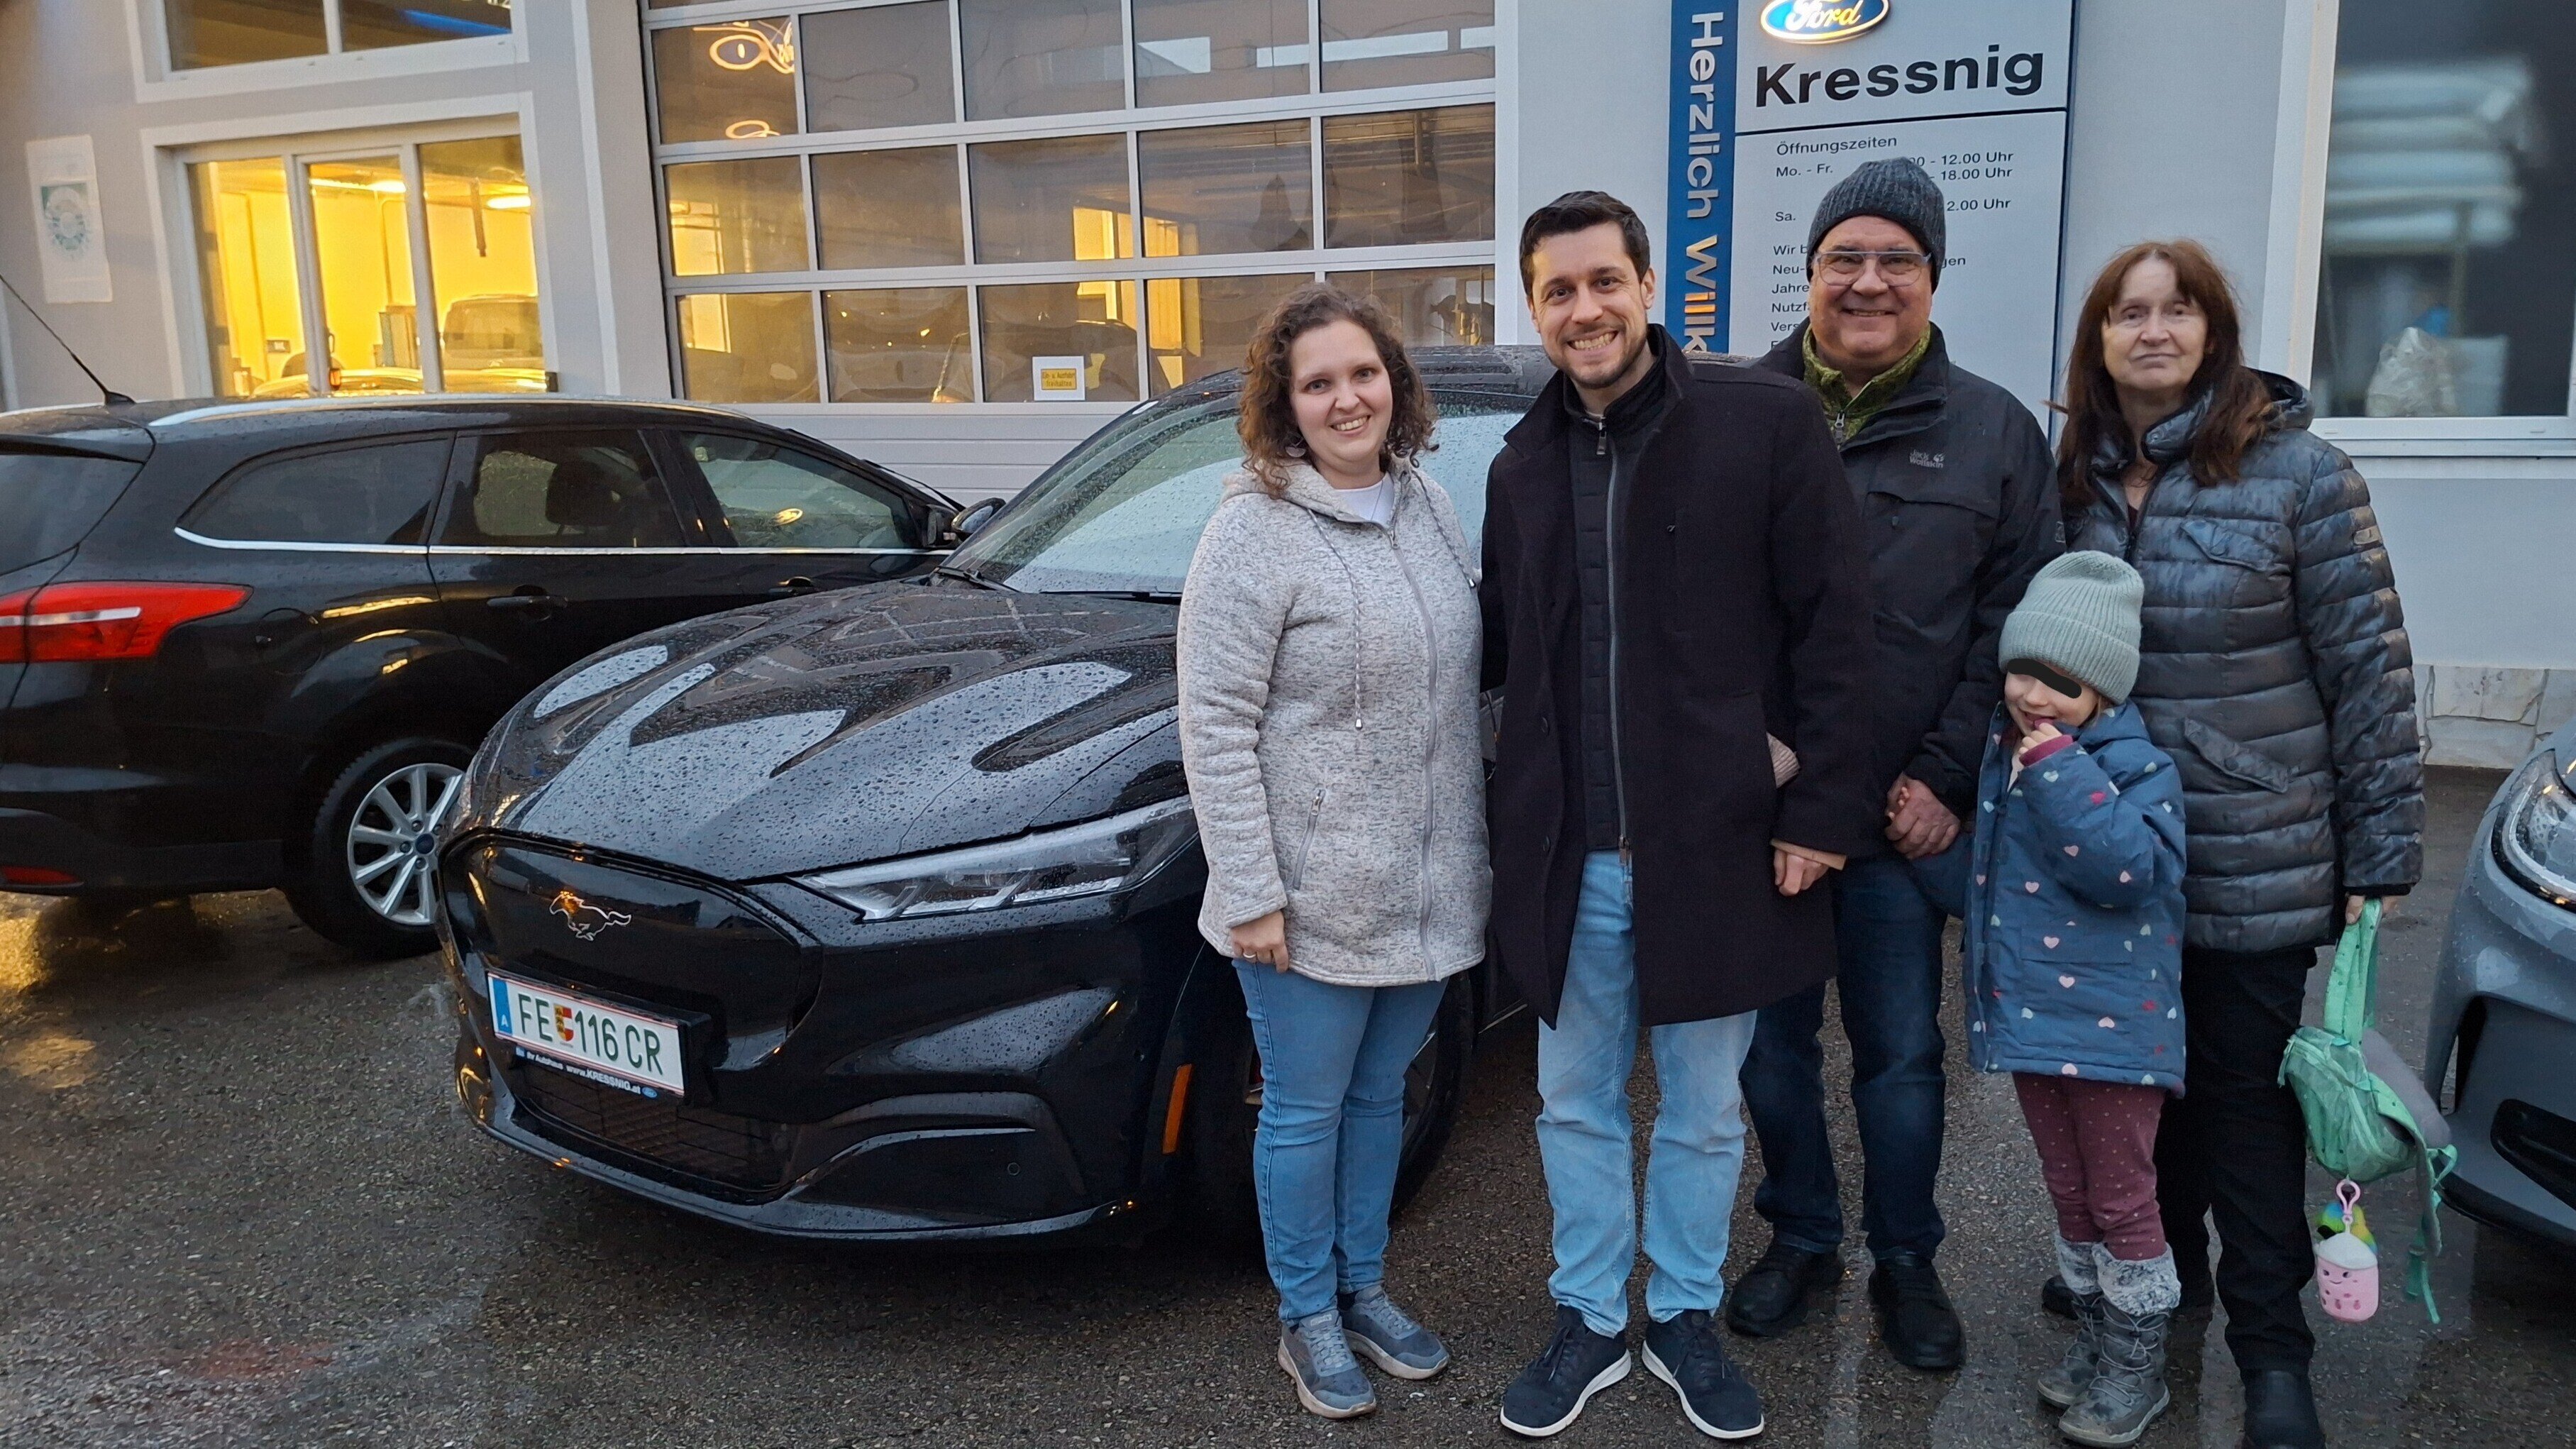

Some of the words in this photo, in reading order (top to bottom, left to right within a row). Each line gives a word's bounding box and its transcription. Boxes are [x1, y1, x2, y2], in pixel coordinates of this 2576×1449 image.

[1785, 0, 1864, 31] Ford
[1755, 44, 2045, 108] Kressnig
[1687, 11, 1724, 219] Herzlich
[1776, 137, 1897, 155] Öffnungszeiten
[1776, 166, 1802, 177] Mo.
[1817, 163, 1834, 174] Fr.
[1941, 153, 1981, 165] 12.00
[1986, 151, 2015, 162] Uhr
[1940, 168, 1980, 181] 18.00
[1985, 167, 2014, 178] Uhr
[1775, 211, 1796, 222] Sa.
[1983, 198, 2012, 209] Uhr
[1773, 245, 1796, 255] Wir
[1772, 264, 1806, 275] Neu-
[1771, 283, 1810, 294] Jahre
[500, 1014, 509, 1027] A
[517, 993, 553, 1042] FE
[575, 1010, 619, 1062] 116
[624, 1024, 664, 1076] CR
